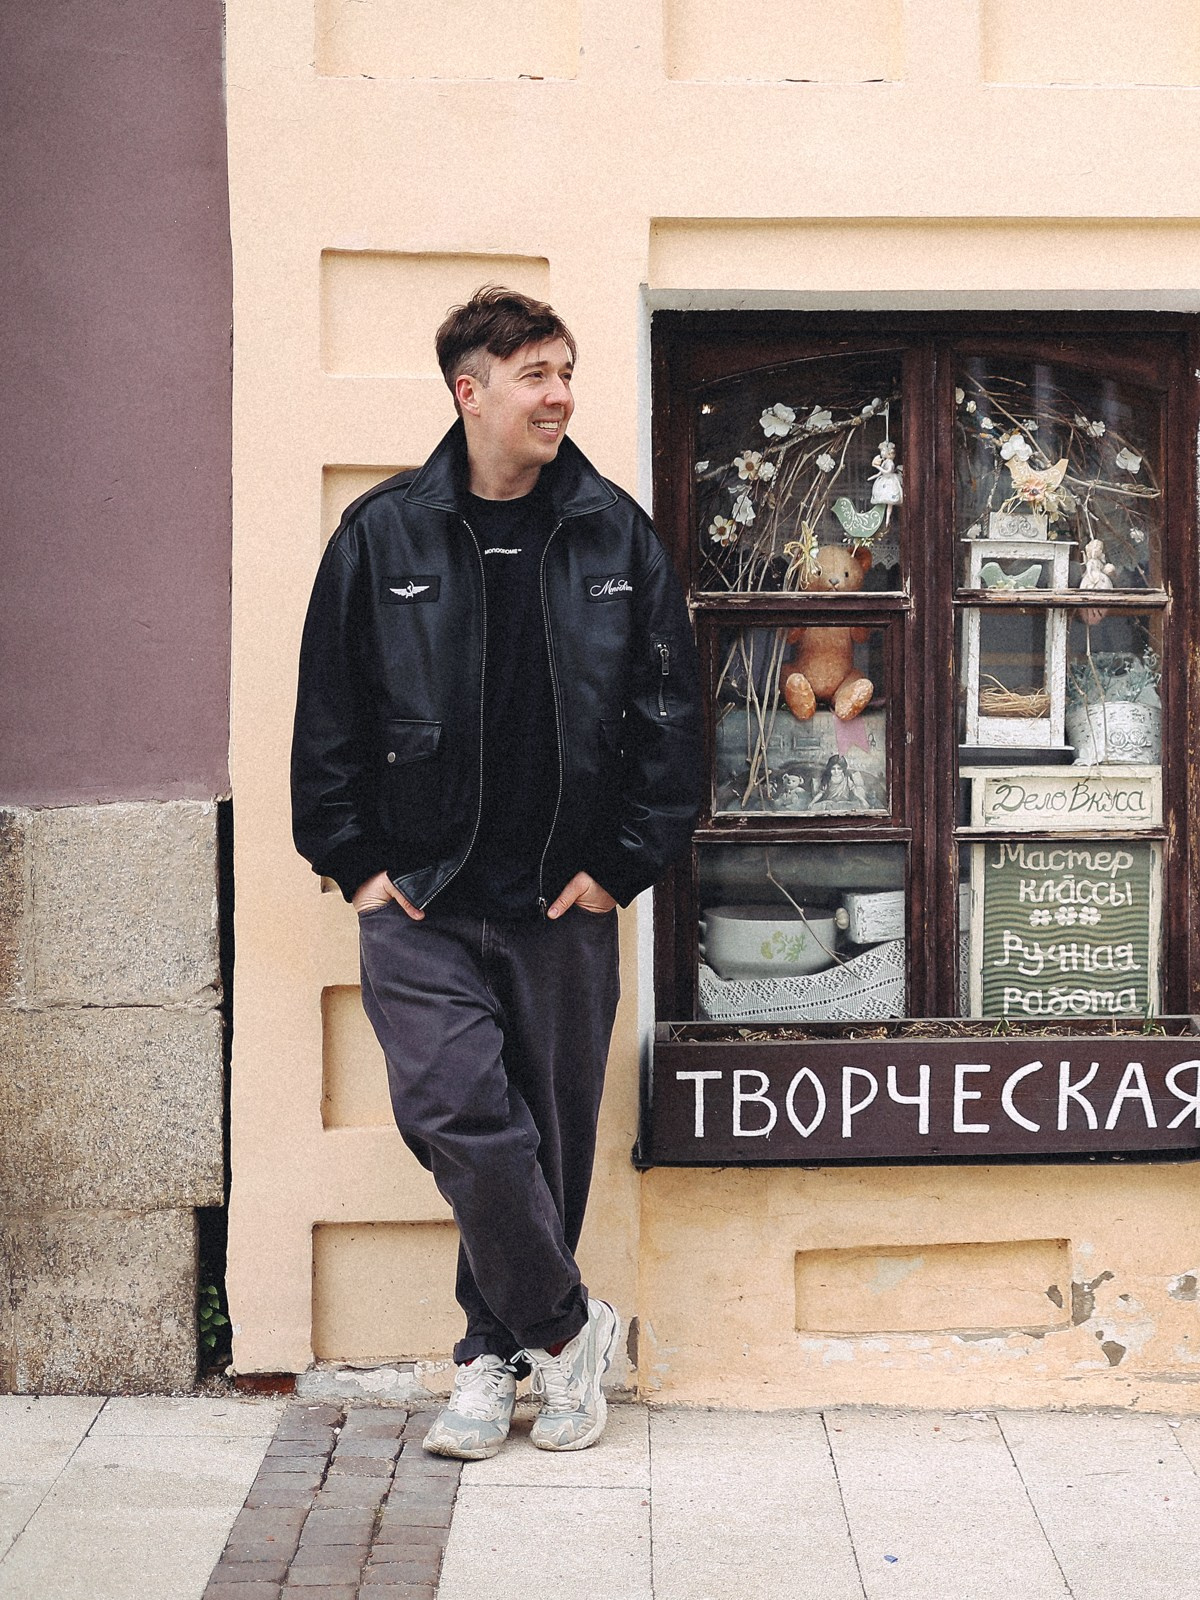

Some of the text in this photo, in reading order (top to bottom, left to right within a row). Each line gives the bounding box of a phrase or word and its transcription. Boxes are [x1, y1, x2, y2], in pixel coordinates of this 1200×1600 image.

[991, 783, 1067, 813] Дело
[991, 843, 1134, 879] Мастер
[993, 929, 1142, 977] Ручная
